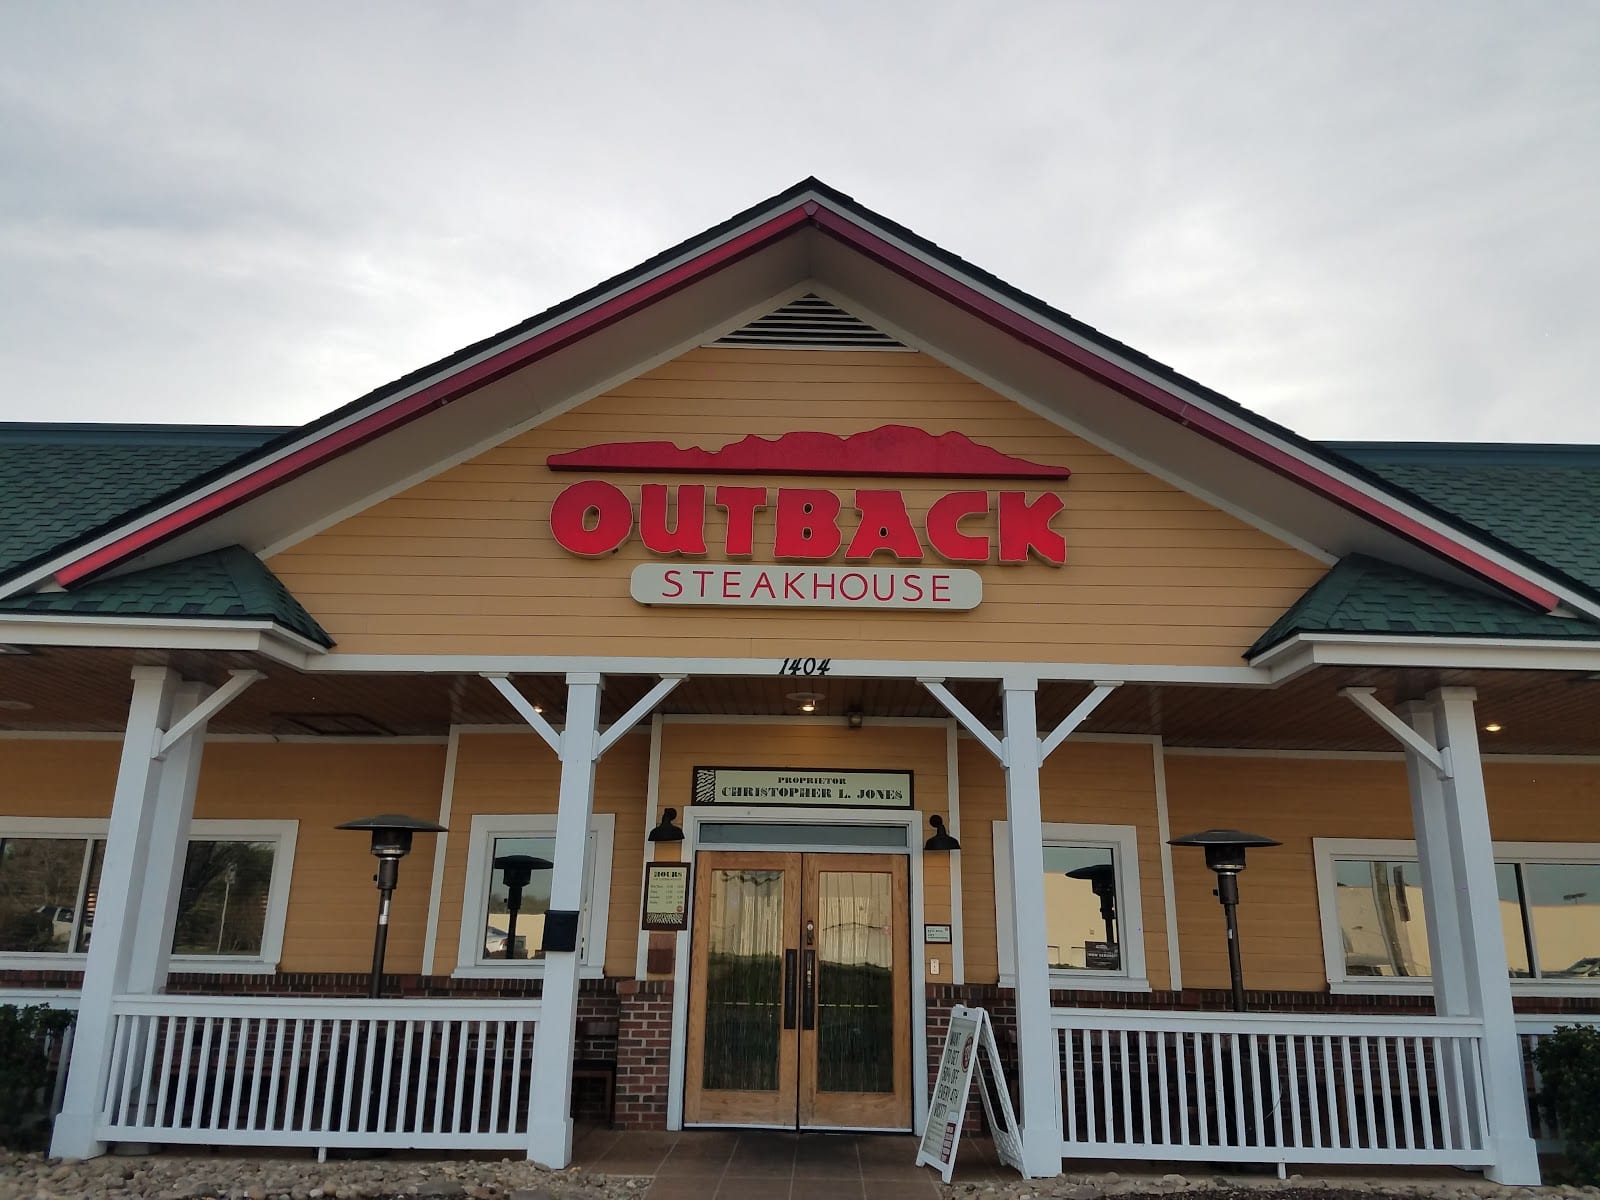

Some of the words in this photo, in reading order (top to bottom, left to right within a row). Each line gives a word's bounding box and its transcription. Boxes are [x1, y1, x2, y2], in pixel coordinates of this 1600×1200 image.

[549, 479, 1067, 567] OUTBACK
[662, 569, 951, 603] STEAKHOUSE
[779, 657, 831, 676] 1404
[777, 776, 847, 785] PROPRIETOR
[721, 786, 832, 799] CHRISTOPHER
[838, 788, 851, 800] L.
[857, 788, 903, 801] JONES
